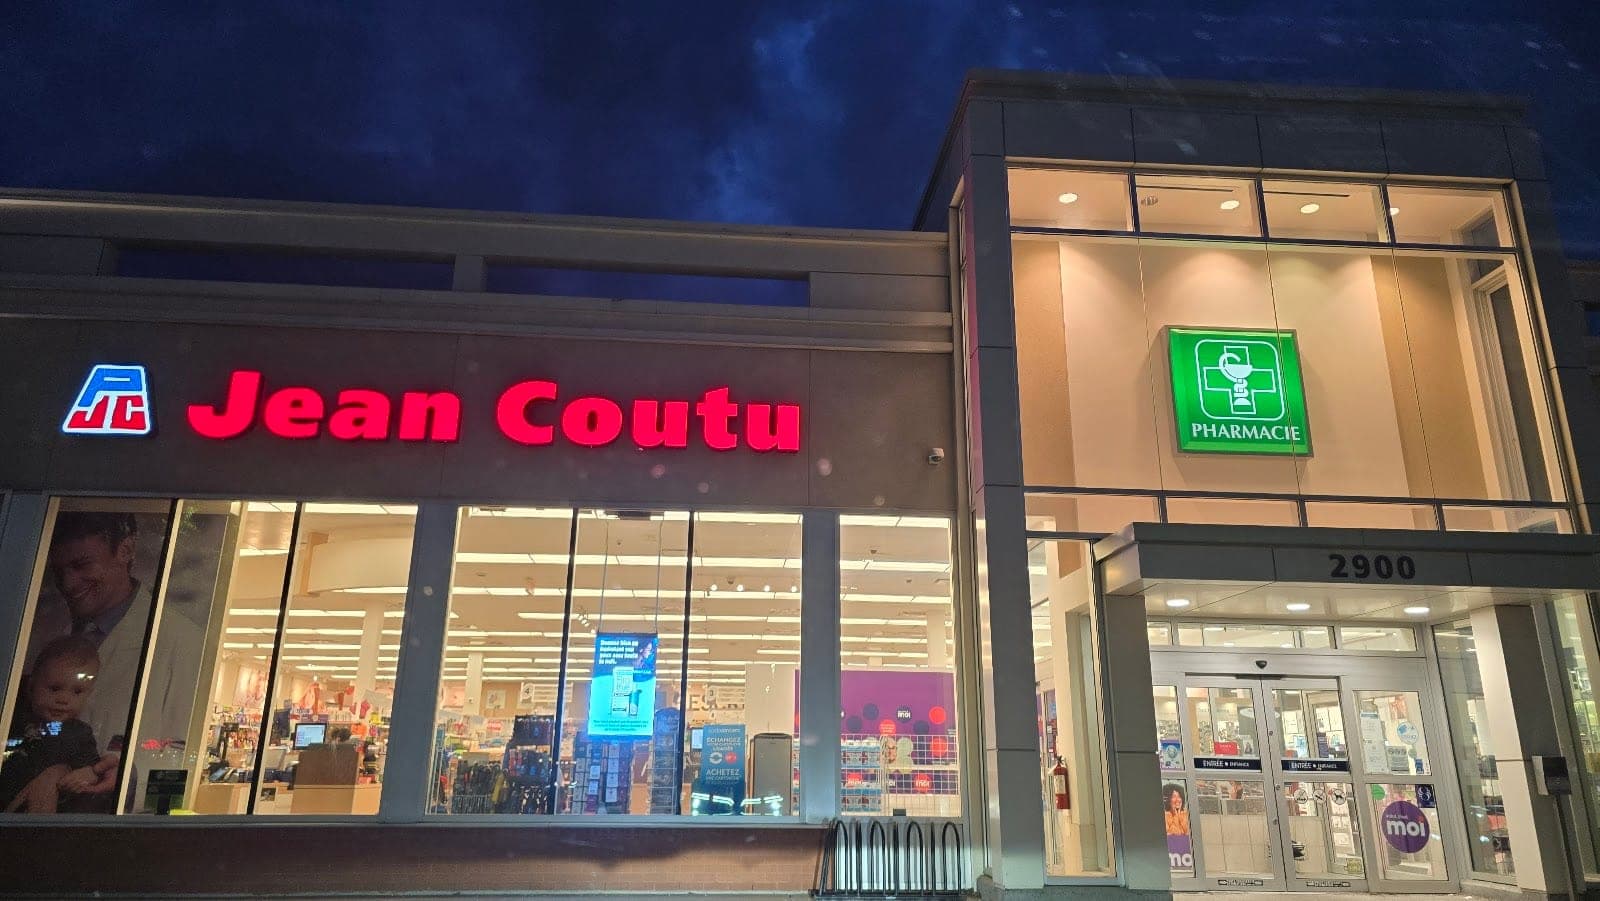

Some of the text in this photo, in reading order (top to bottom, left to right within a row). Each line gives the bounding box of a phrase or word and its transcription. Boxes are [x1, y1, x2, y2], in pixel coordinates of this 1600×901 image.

[188, 370, 801, 451] Jean Coutu
[1191, 422, 1301, 441] PHARMACIE
[1328, 553, 1416, 579] 2900
[1386, 815, 1426, 837] moi
